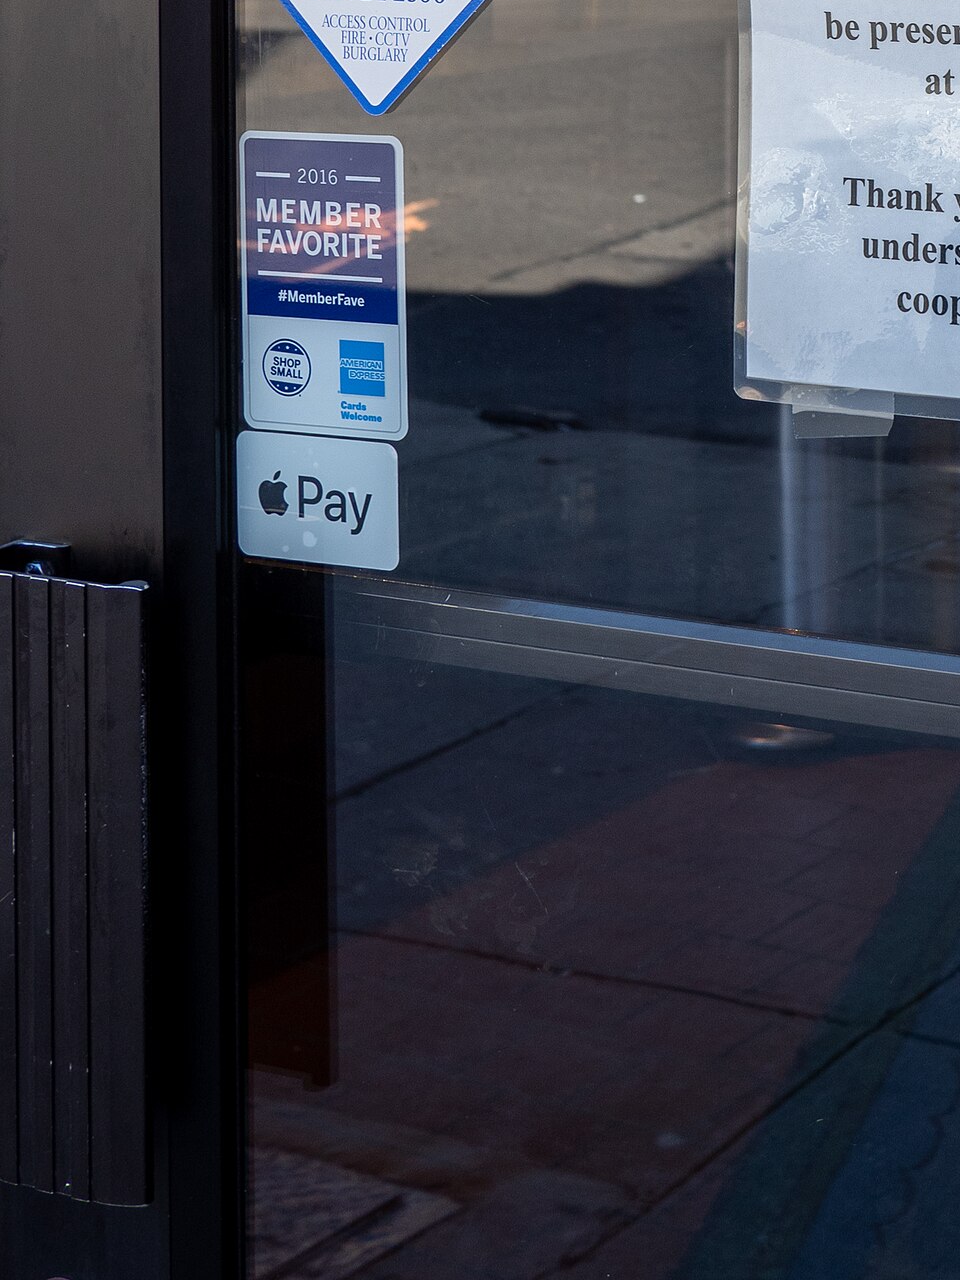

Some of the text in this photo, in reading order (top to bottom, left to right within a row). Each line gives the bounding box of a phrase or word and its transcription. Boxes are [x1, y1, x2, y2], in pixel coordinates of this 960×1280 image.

[322, 14, 430, 33] ACCESS CONTROL
[825, 12, 860, 41] be
[340, 30, 411, 47] FIRE CCTV
[342, 46, 408, 63] BURGLARY
[925, 71, 954, 98] at
[297, 168, 338, 186] 2016
[842, 176, 944, 214] Thank
[256, 198, 382, 229] MEMBER
[257, 228, 383, 260] FAVORITE
[278, 289, 366, 308] #MemberFave
[272, 356, 301, 370] SHOP
[340, 358, 382, 370] AMERICAN
[270, 366, 304, 380] SMALL
[348, 370, 385, 381] EXPRESS
[340, 400, 368, 412] Cards
[340, 410, 383, 423] Welcome
[298, 475, 372, 536] Pay
